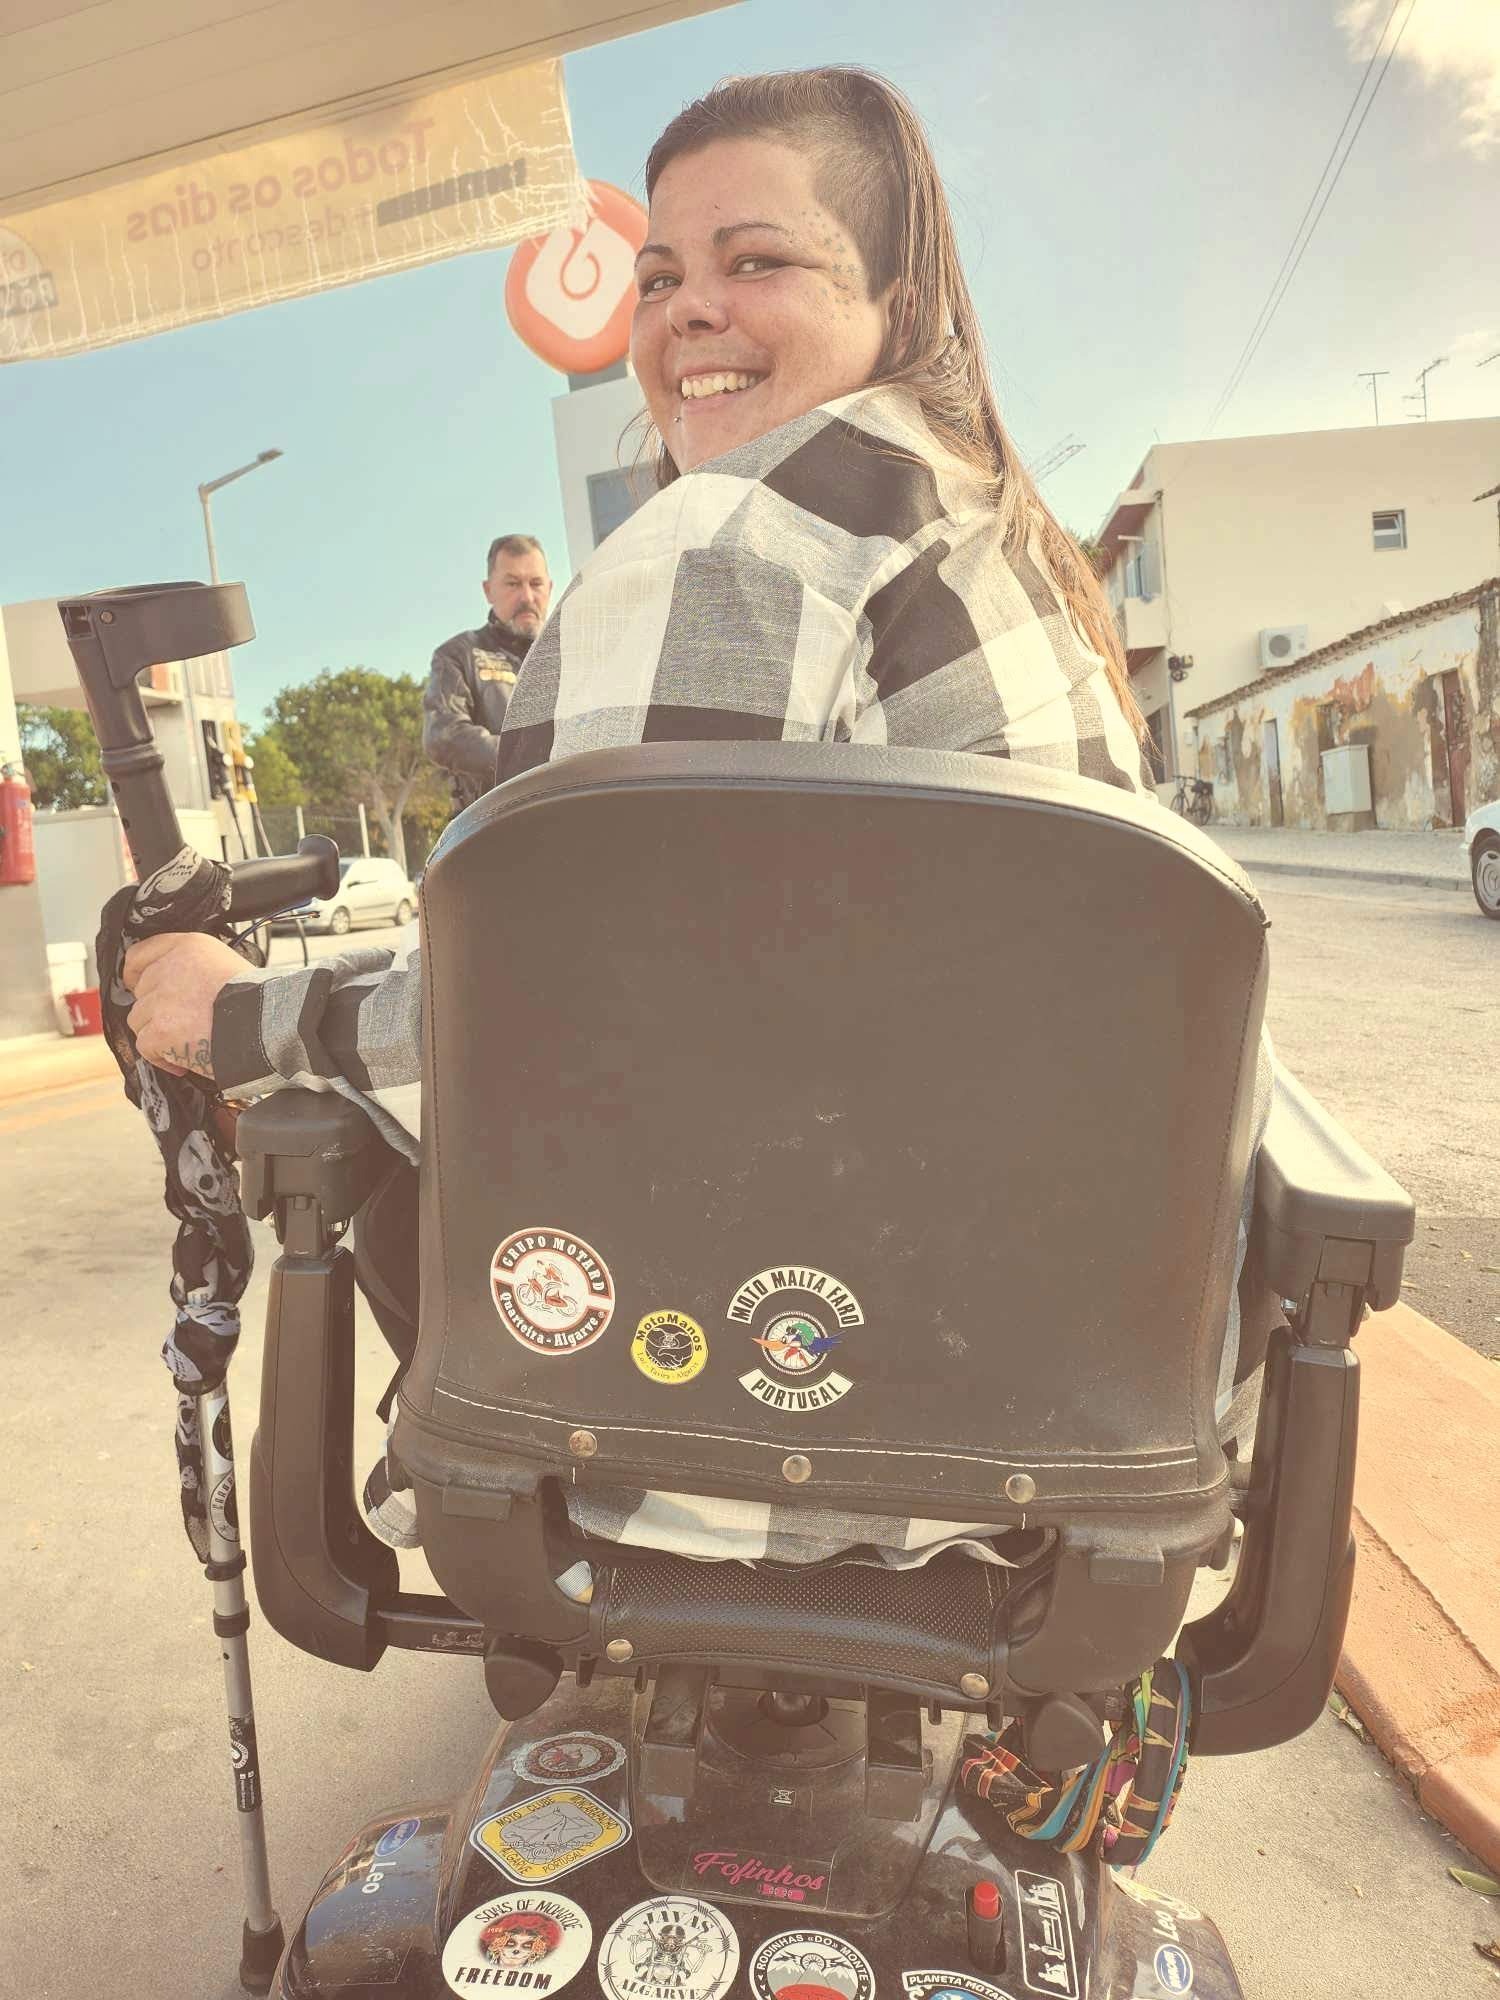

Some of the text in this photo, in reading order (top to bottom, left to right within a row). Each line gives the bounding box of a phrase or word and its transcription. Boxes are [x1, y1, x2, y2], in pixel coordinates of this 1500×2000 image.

[502, 1235, 605, 1291] GRUPO MOTARD
[731, 1270, 860, 1325] MOTO MALTA FARO
[499, 1291, 544, 1345] Quarteira
[554, 1316, 599, 1347] Algarve
[636, 1313, 703, 1352] MotoManos
[750, 1378, 842, 1409] PORTUGAL
[496, 1796, 554, 1827] MOTO CLUBE
[361, 1861, 397, 1894] Leo
[542, 1848, 586, 1874] PORTUGAL
[693, 1852, 826, 1890] Fofinhos
[516, 1899, 534, 1910] OF
[1152, 1909, 1180, 1943] Leo
[756, 1934, 804, 1971] RODINHAS
[839, 1946, 869, 1982] MONTE
[454, 1966, 552, 1990] FREEDOM
[908, 1974, 962, 1986] PLANETA
